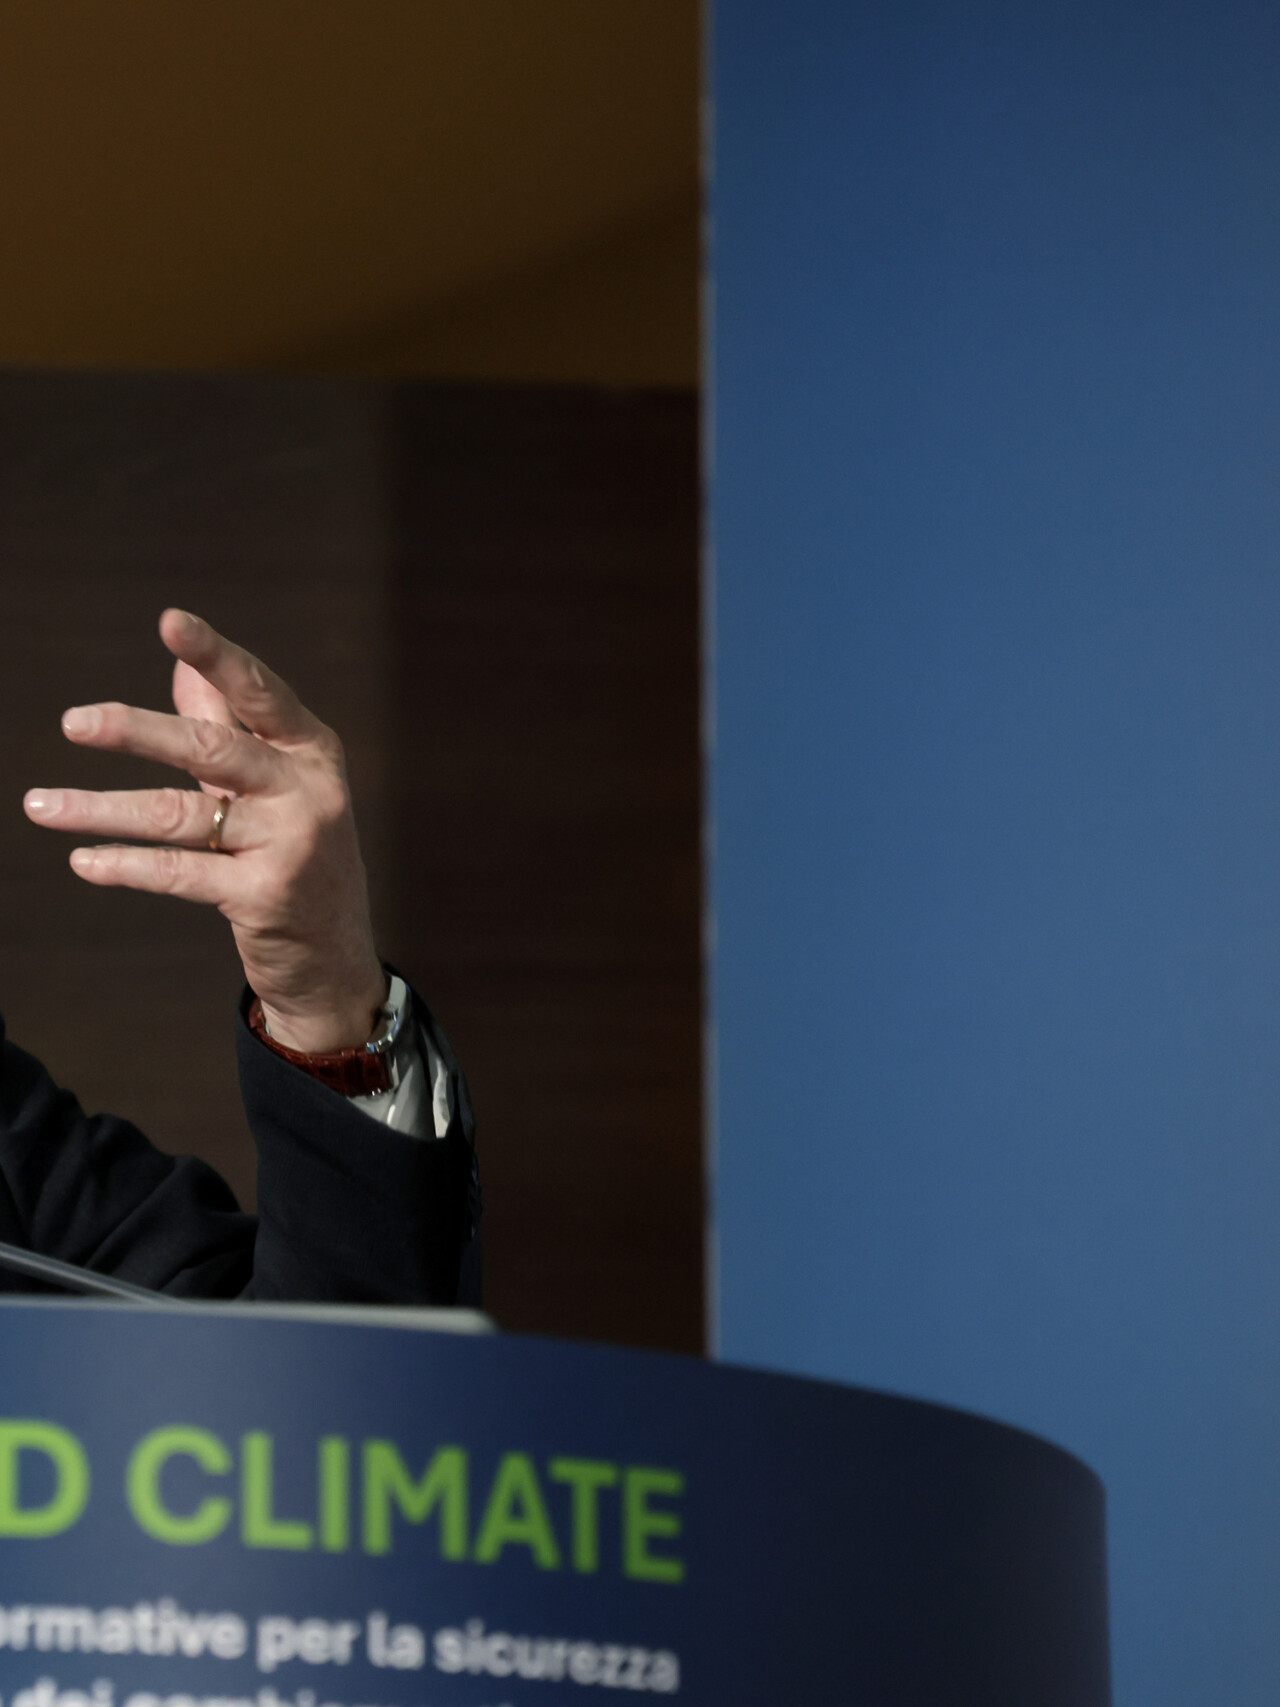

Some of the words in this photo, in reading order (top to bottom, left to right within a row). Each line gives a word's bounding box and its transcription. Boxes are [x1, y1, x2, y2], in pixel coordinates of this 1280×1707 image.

[128, 1424, 684, 1583] CLIMATE
[256, 1616, 360, 1672] per
[367, 1612, 426, 1670] la
[433, 1619, 680, 1693] sicurezza
